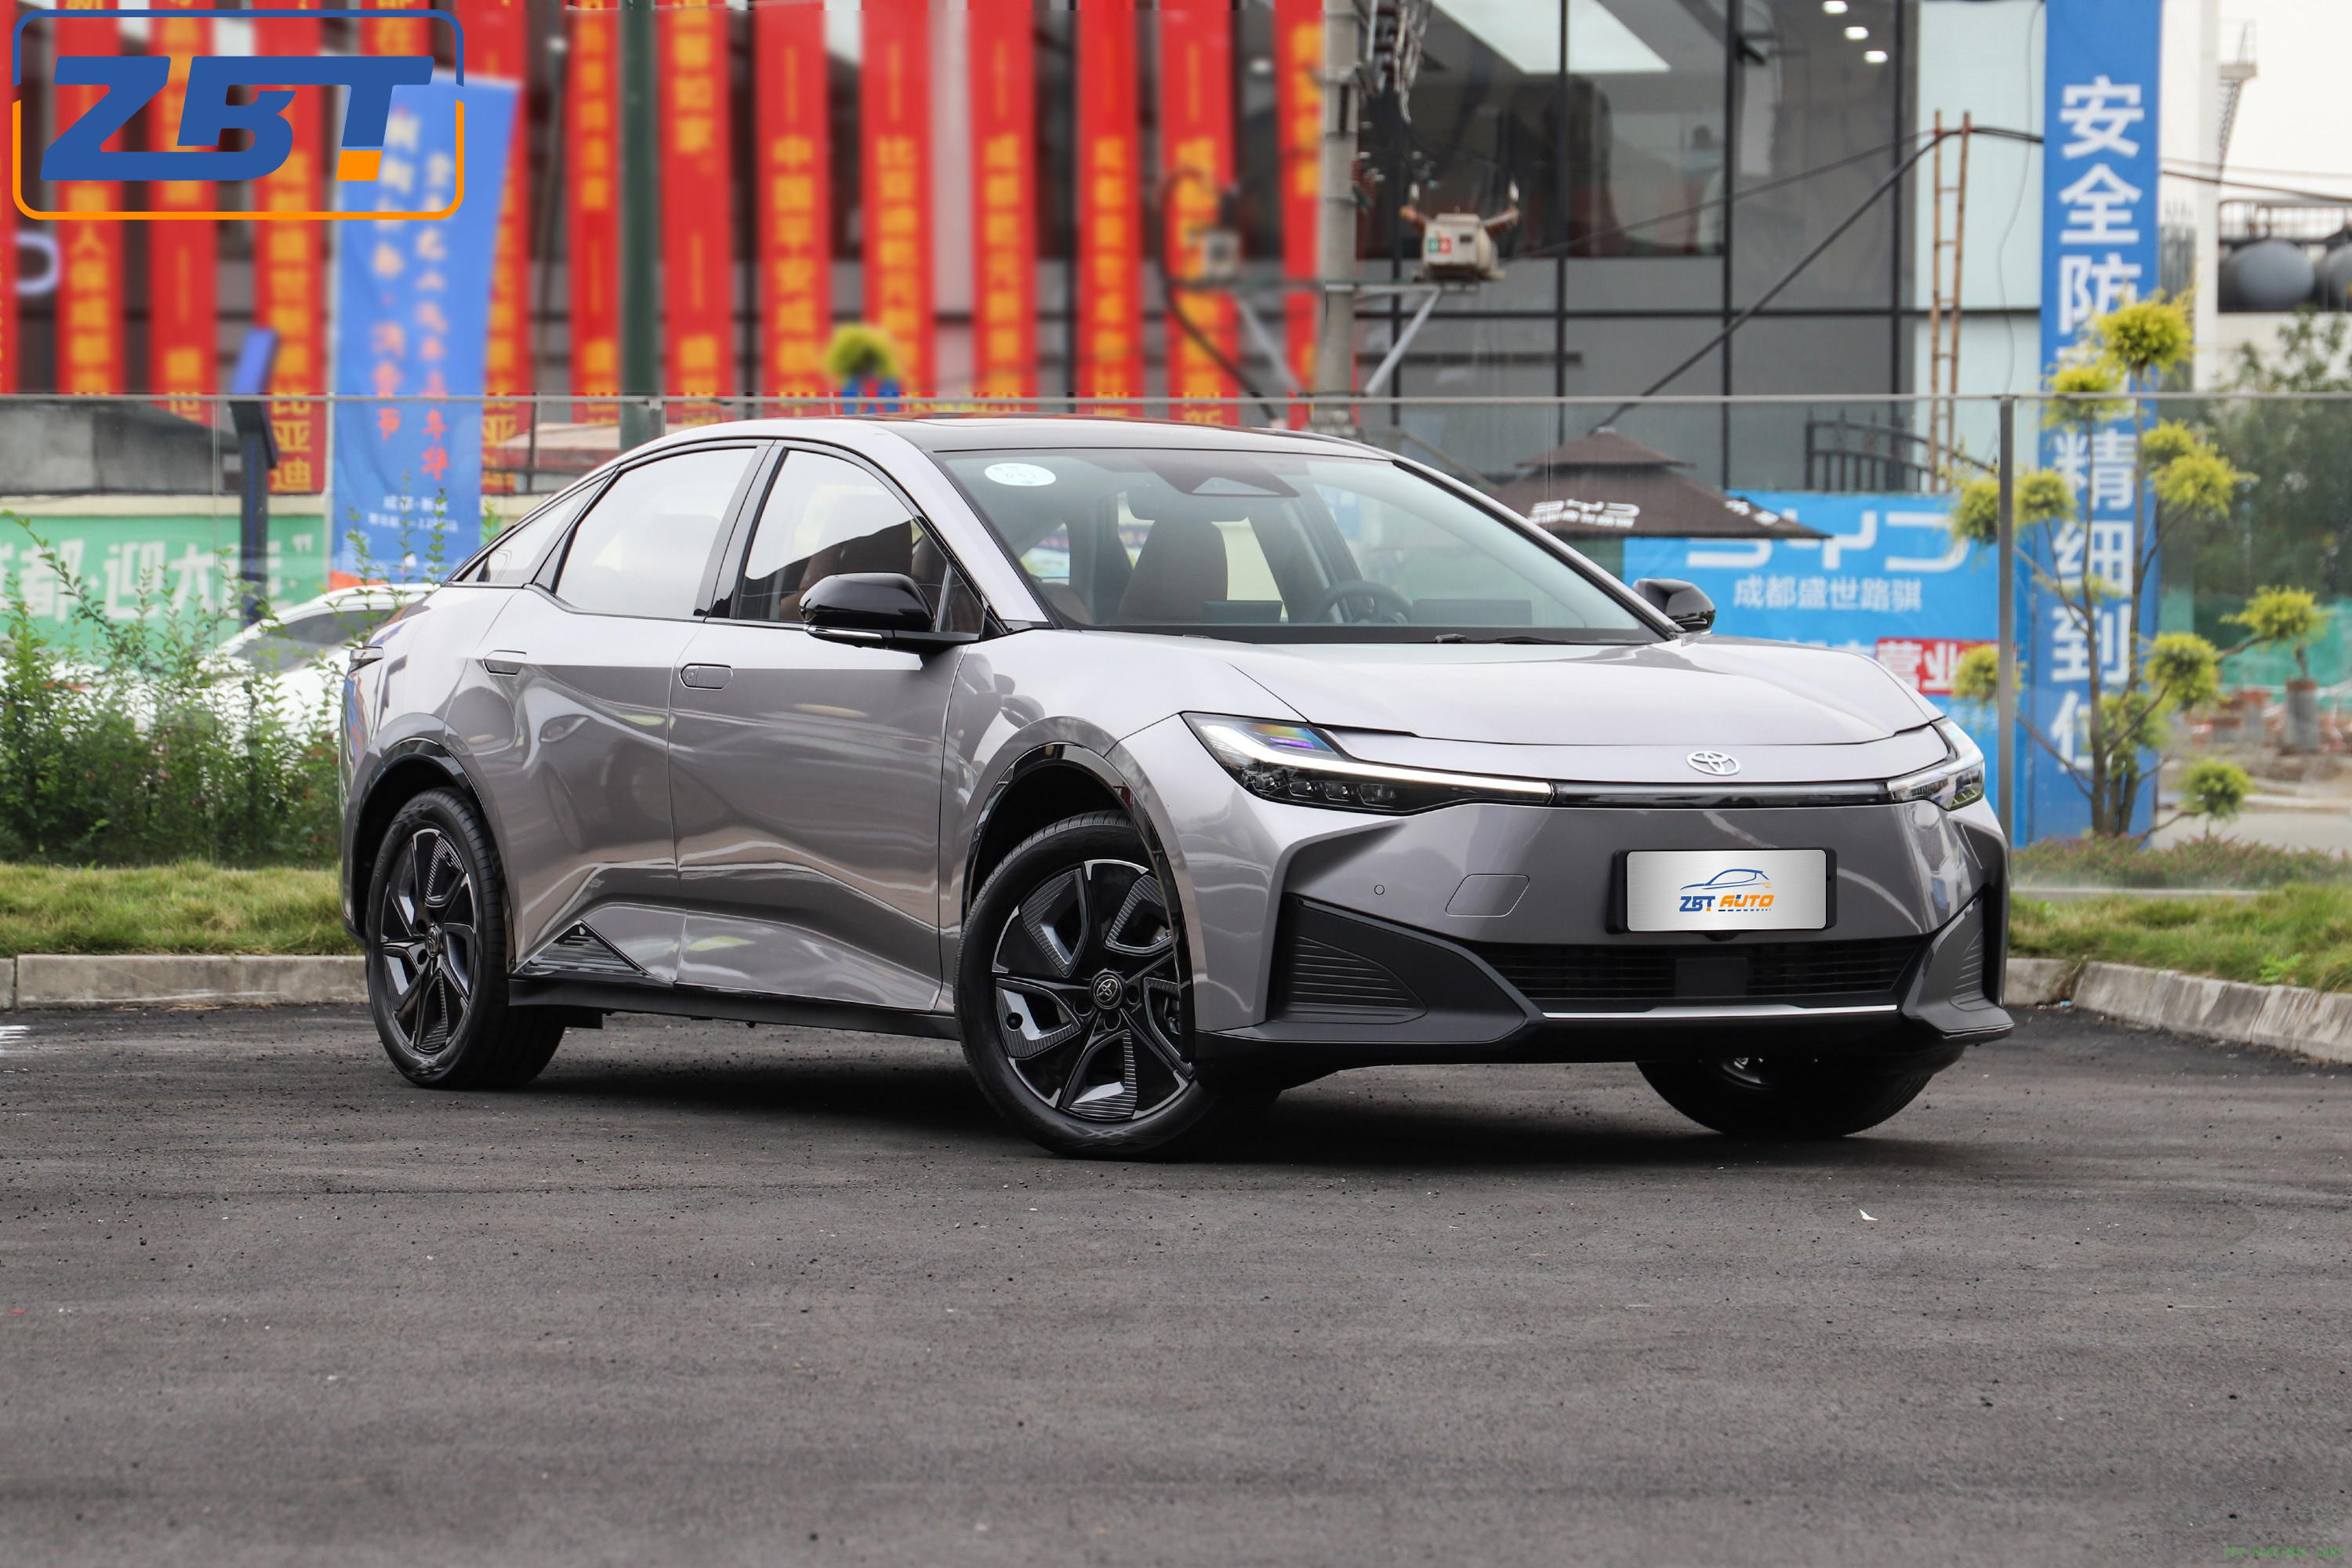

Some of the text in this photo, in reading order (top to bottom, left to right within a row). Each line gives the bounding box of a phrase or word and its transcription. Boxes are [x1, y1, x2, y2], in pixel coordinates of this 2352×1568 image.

[2049, 75, 2146, 775] 安全防精细到
[1878, 640, 2004, 692] 营业
